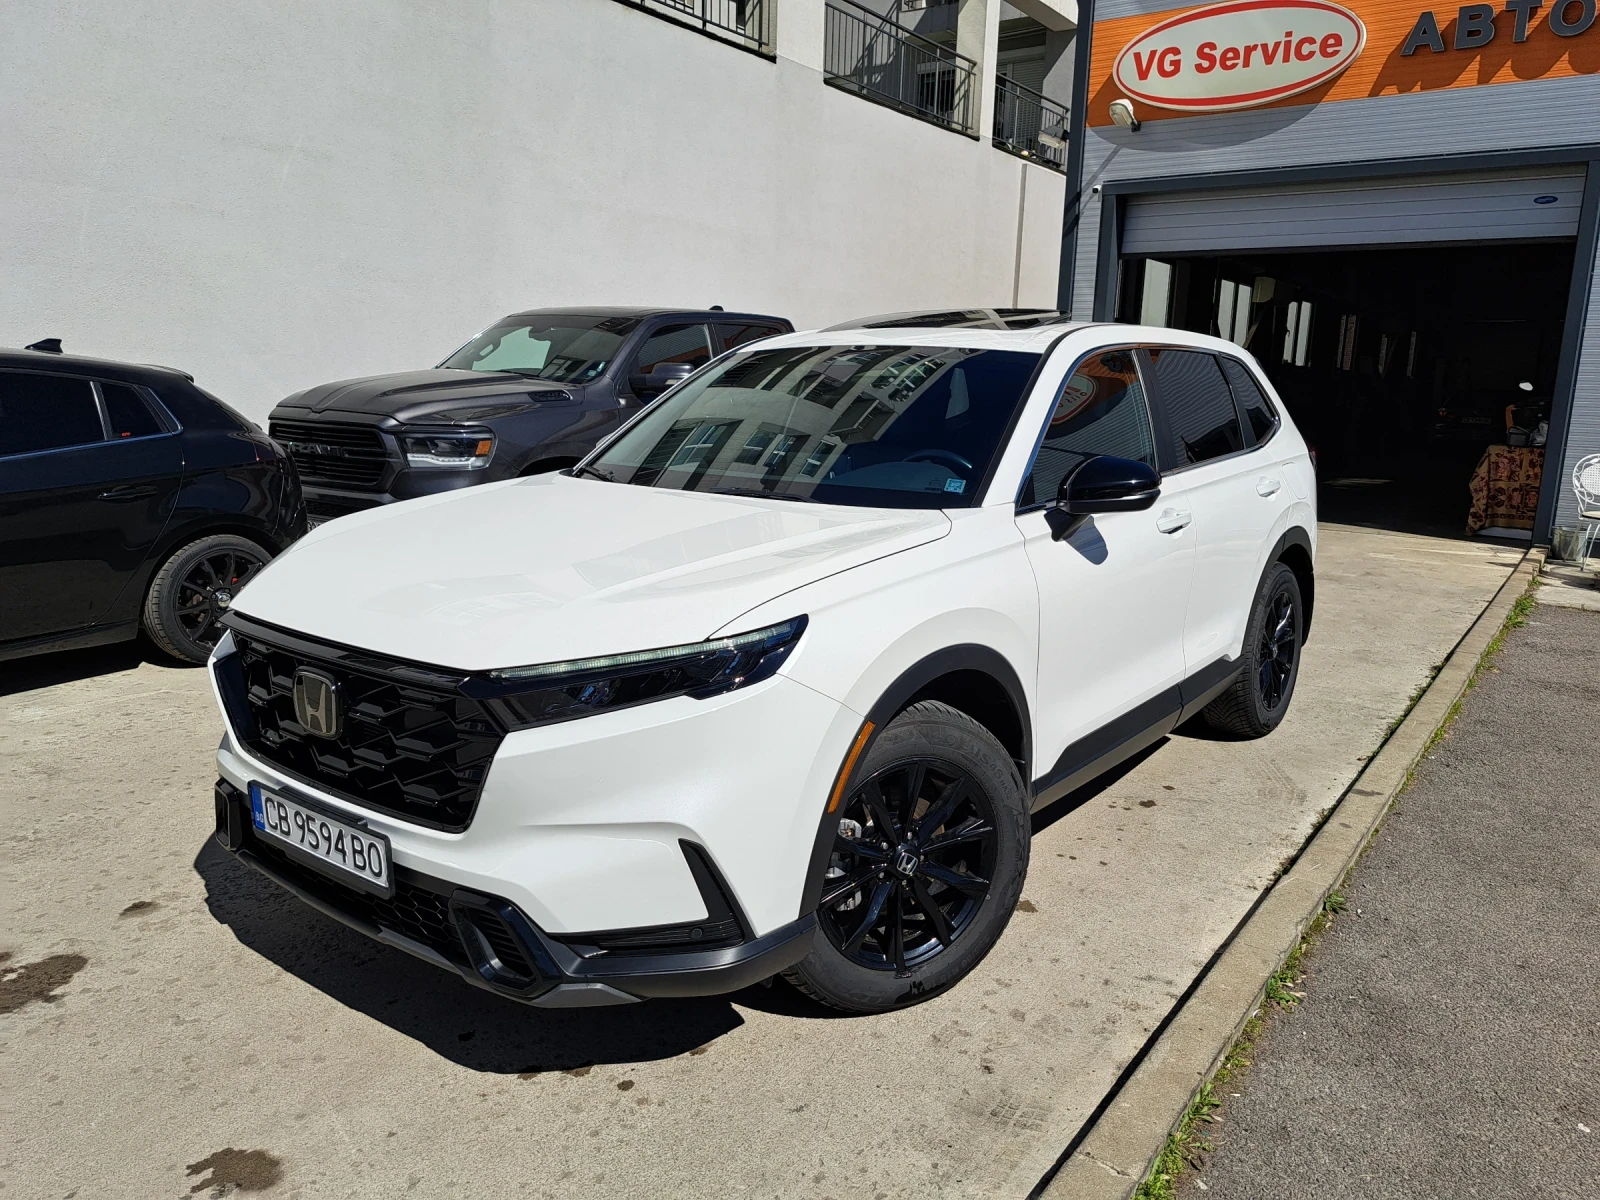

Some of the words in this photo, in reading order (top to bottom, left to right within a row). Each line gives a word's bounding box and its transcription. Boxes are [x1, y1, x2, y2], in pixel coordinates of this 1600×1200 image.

[1133, 46, 1182, 81] VG
[1194, 31, 1343, 74] Service
[1400, 0, 1597, 56] АВТО
[265, 797, 291, 836] CB
[294, 811, 347, 863] 9594
[351, 834, 382, 877] BO
